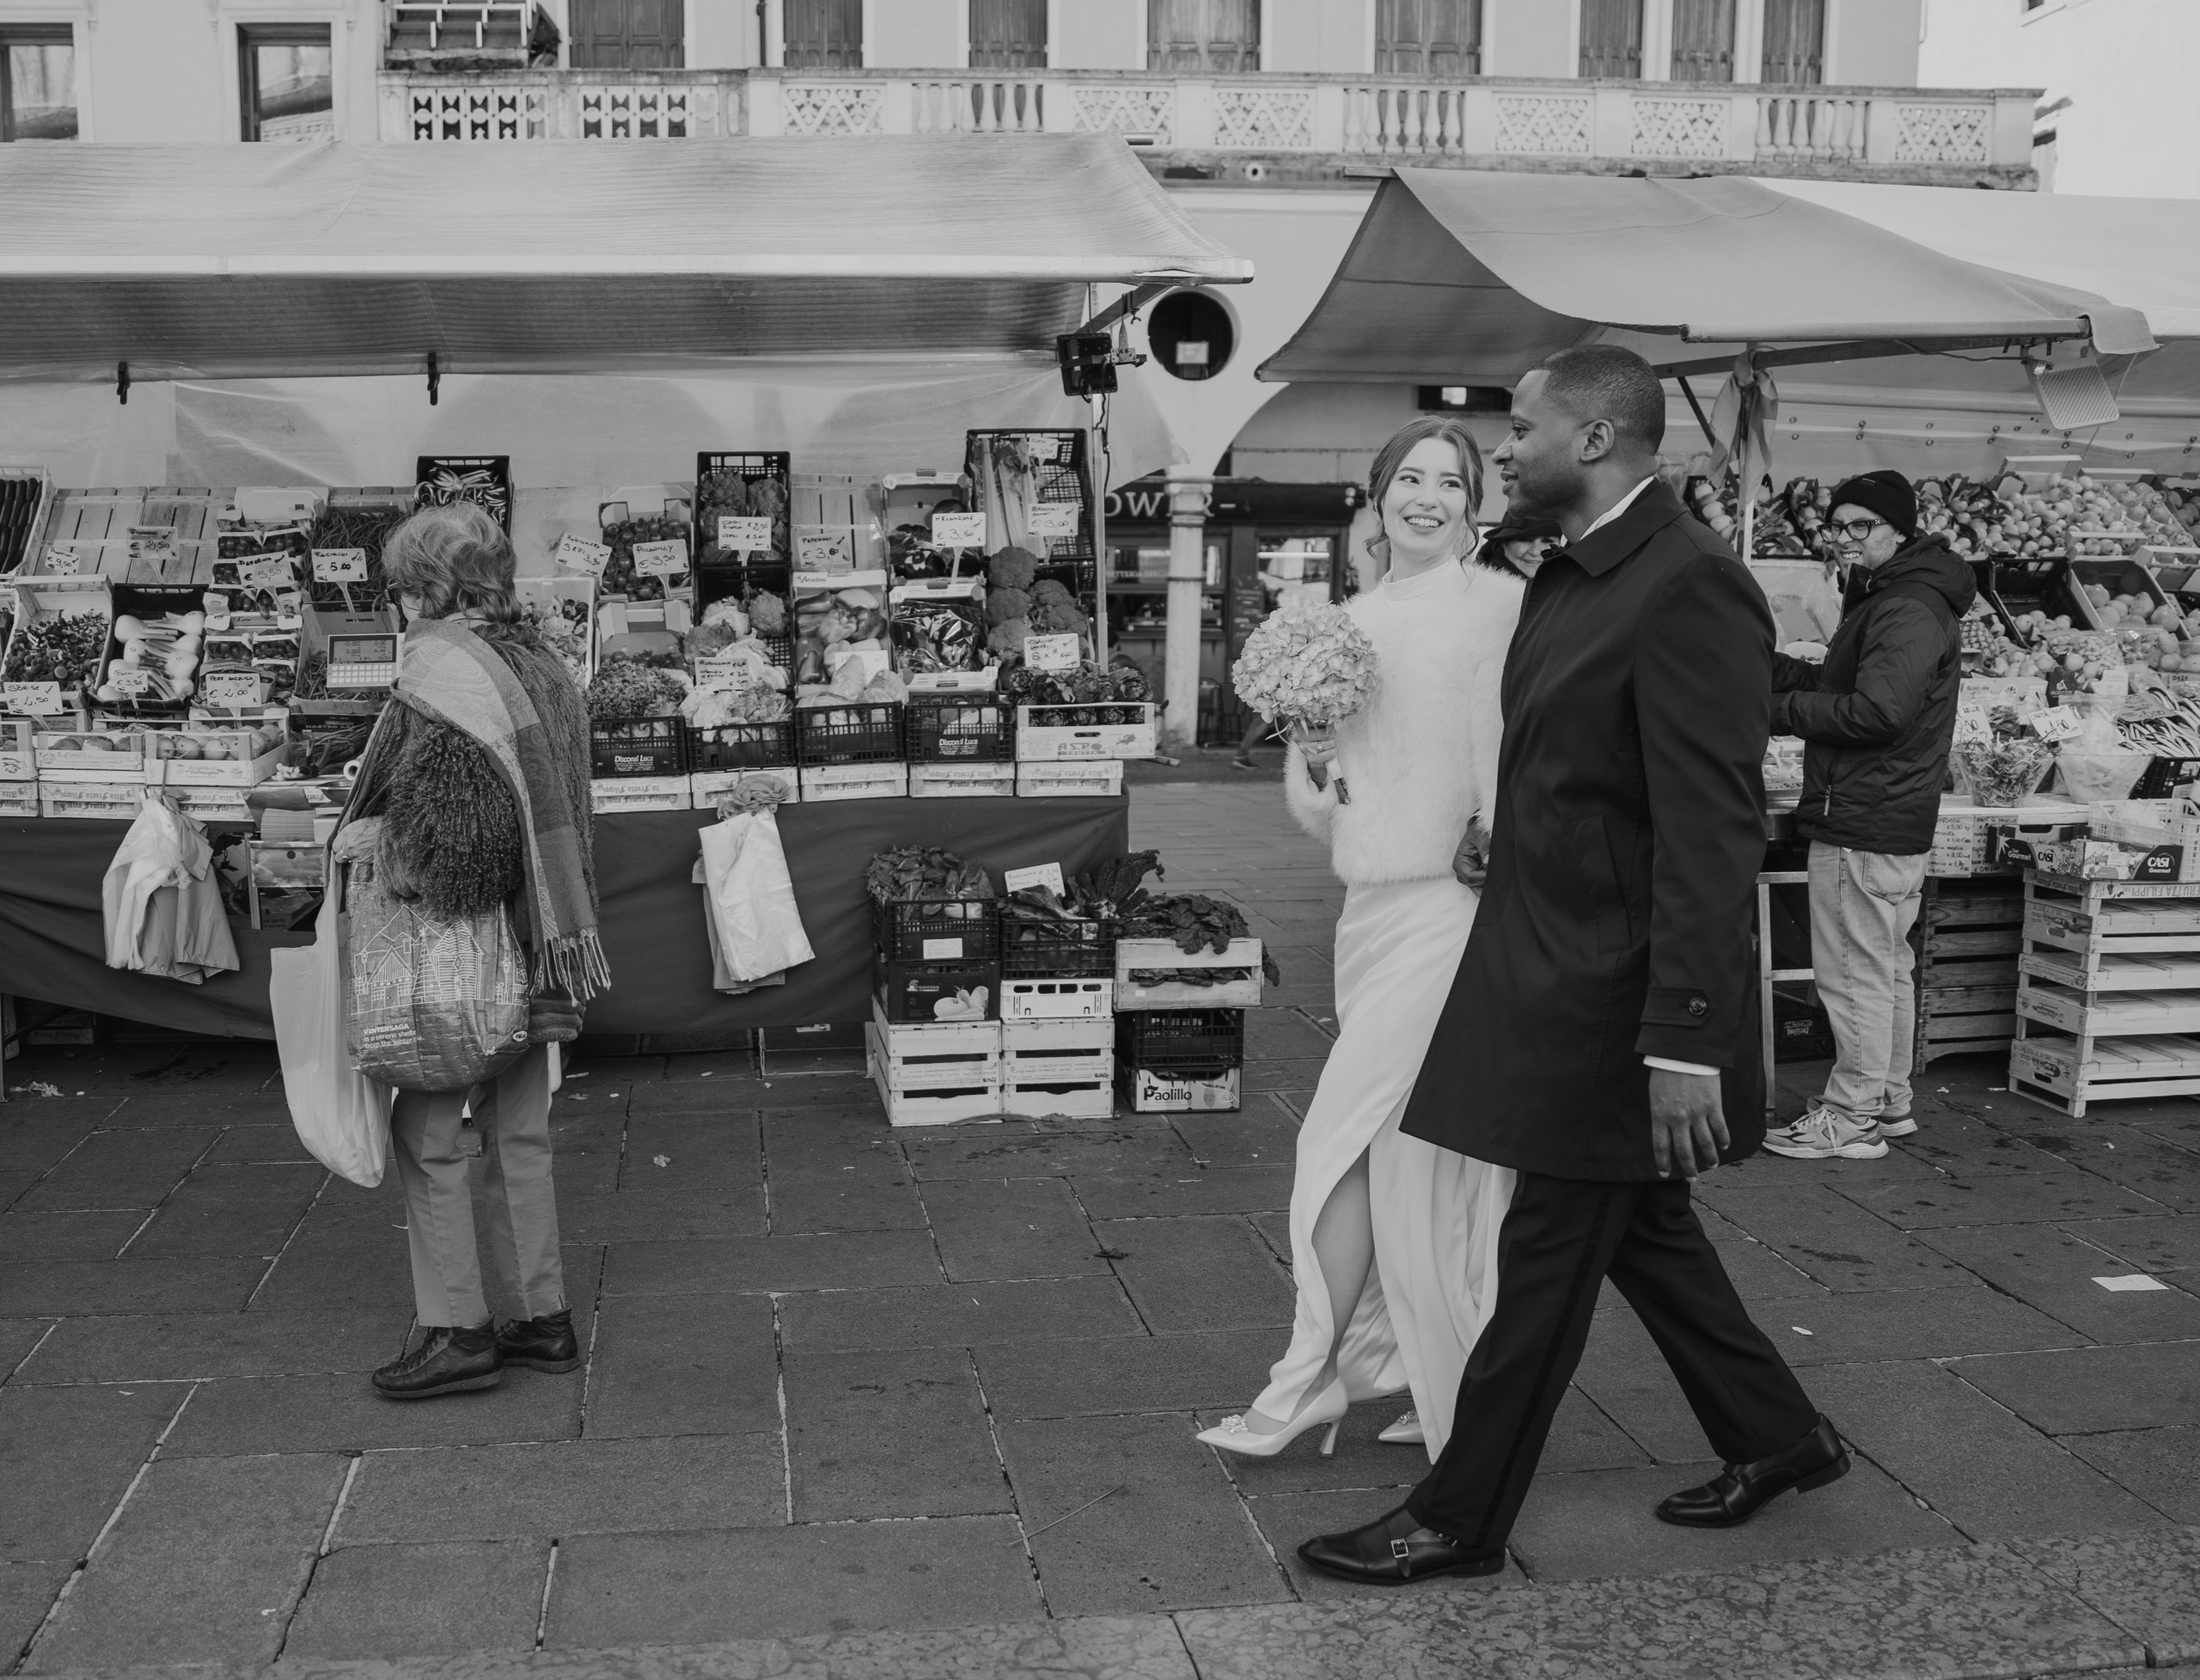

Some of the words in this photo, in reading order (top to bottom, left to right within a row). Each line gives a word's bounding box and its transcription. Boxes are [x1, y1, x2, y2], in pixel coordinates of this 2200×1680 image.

[2008, 851, 2032, 862] Gourmet
[2038, 852, 2053, 863] CASI
[2148, 857, 2170, 868] CASI
[2132, 886, 2163, 897] FILIPPI
[363, 1023, 410, 1035] VINTERSAGA
[1144, 1084, 1193, 1101] Paolillo
